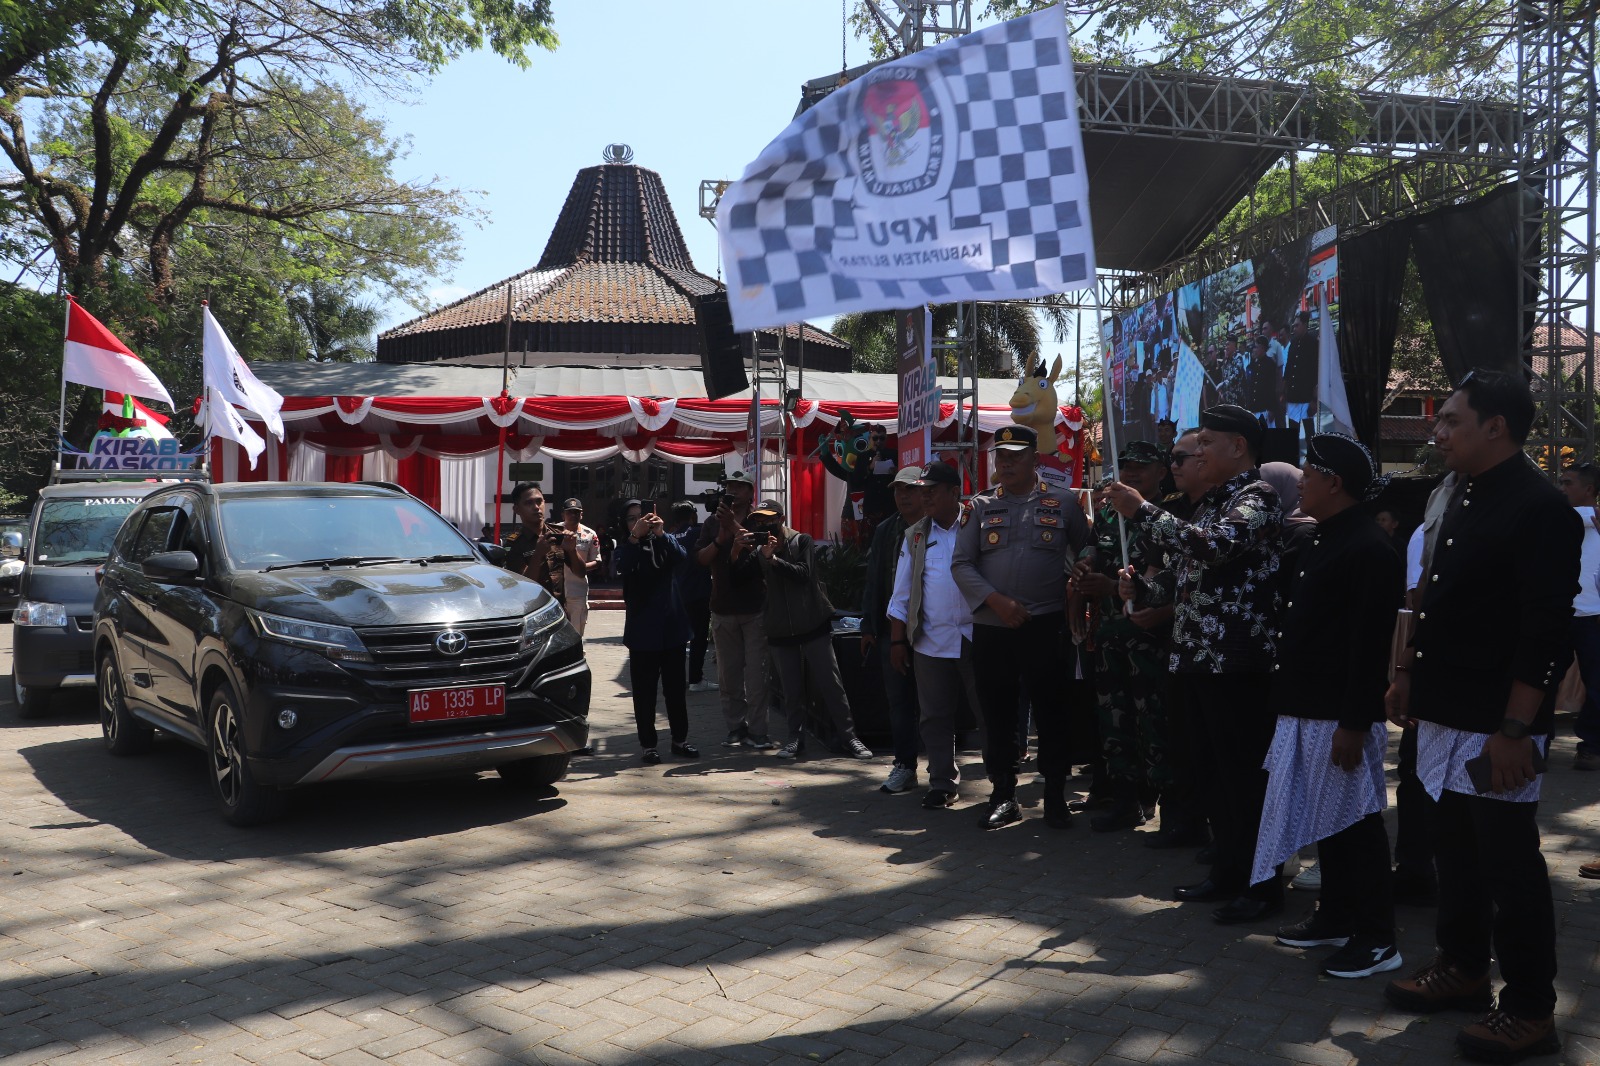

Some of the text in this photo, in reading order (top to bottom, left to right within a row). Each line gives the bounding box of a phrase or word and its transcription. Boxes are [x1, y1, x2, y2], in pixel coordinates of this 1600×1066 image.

[904, 361, 937, 402] KIRAB
[898, 389, 942, 434] MASKOT
[94, 438, 178, 455] KIRAB
[77, 456, 195, 470] MASKOT
[412, 687, 502, 713] AG 1335 LP
